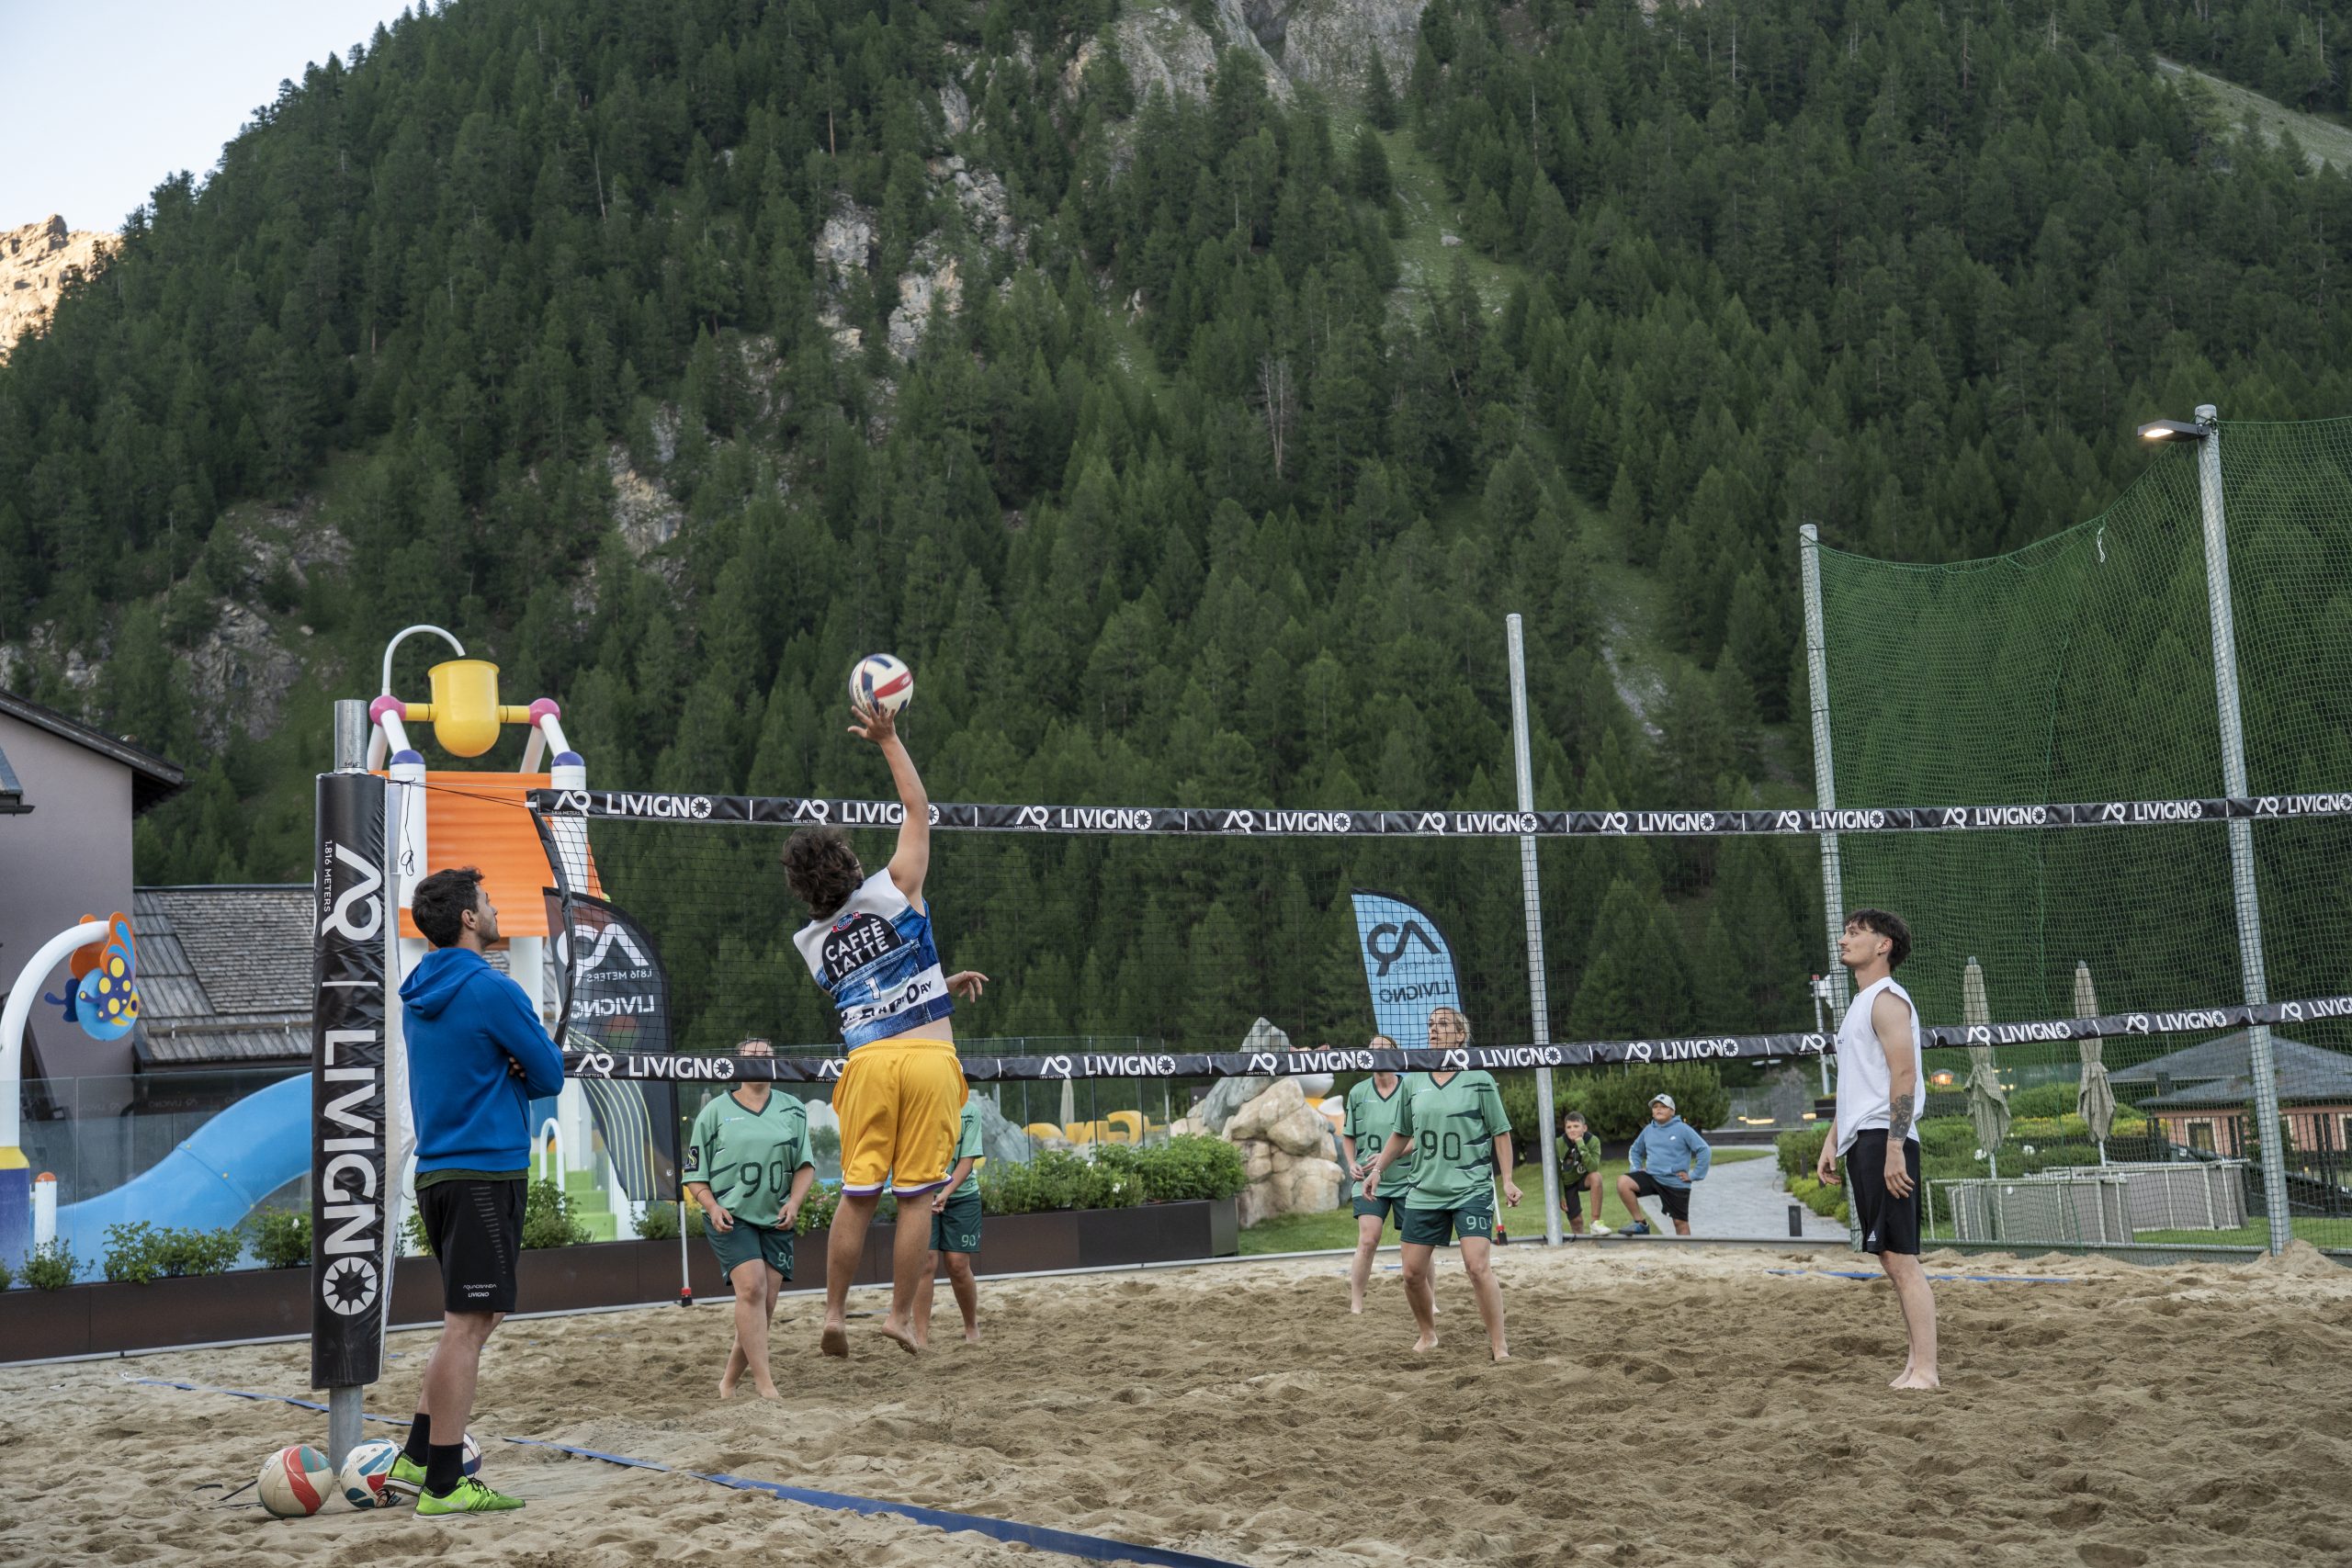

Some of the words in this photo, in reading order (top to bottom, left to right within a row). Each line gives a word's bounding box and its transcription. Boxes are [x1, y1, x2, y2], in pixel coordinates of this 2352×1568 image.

[606, 794, 712, 818] LIVIGNO
[842, 803, 940, 826] LIVIGO
[2134, 801, 2202, 821] LIVIGNO
[2287, 794, 2352, 814] LIVIGNO
[1061, 808, 1152, 830] LIVIGNO
[1265, 812, 1351, 833] LIVIGNO
[1456, 813, 1537, 833] LIVIGNO
[1638, 812, 1715, 832] LIVIGNO
[1810, 810, 1885, 830] LIVIGNO
[1975, 807, 2047, 827] LIVIGNO
[323, 840, 333, 863] 1.816
[323, 868, 332, 912] METERS
[826, 919, 886, 962] CAFFÈ
[831, 936, 890, 978] LATTE
[865, 976, 881, 1000] 1
[2308, 997, 2352, 1018] LIVIG
[1998, 1021, 2071, 1043] LIVIGNO
[2156, 1010, 2227, 1032] LIVIGNO
[1479, 1046, 1562, 1067] LIVIGNO
[1660, 1038, 1738, 1060] LIVIGNO
[628, 1056, 735, 1079] LIVIGNO
[1083, 1055, 1176, 1076] LIVIGNO
[1288, 1050, 1374, 1073] LIVIGNO
[1420, 1130, 1461, 1160] 90
[322, 1030, 378, 1315] LIVIGNO
[740, 1160, 782, 1198] 90
[1466, 1215, 1487, 1230] 90
[961, 1235, 976, 1247] 90
[777, 1252, 794, 1270] 90
